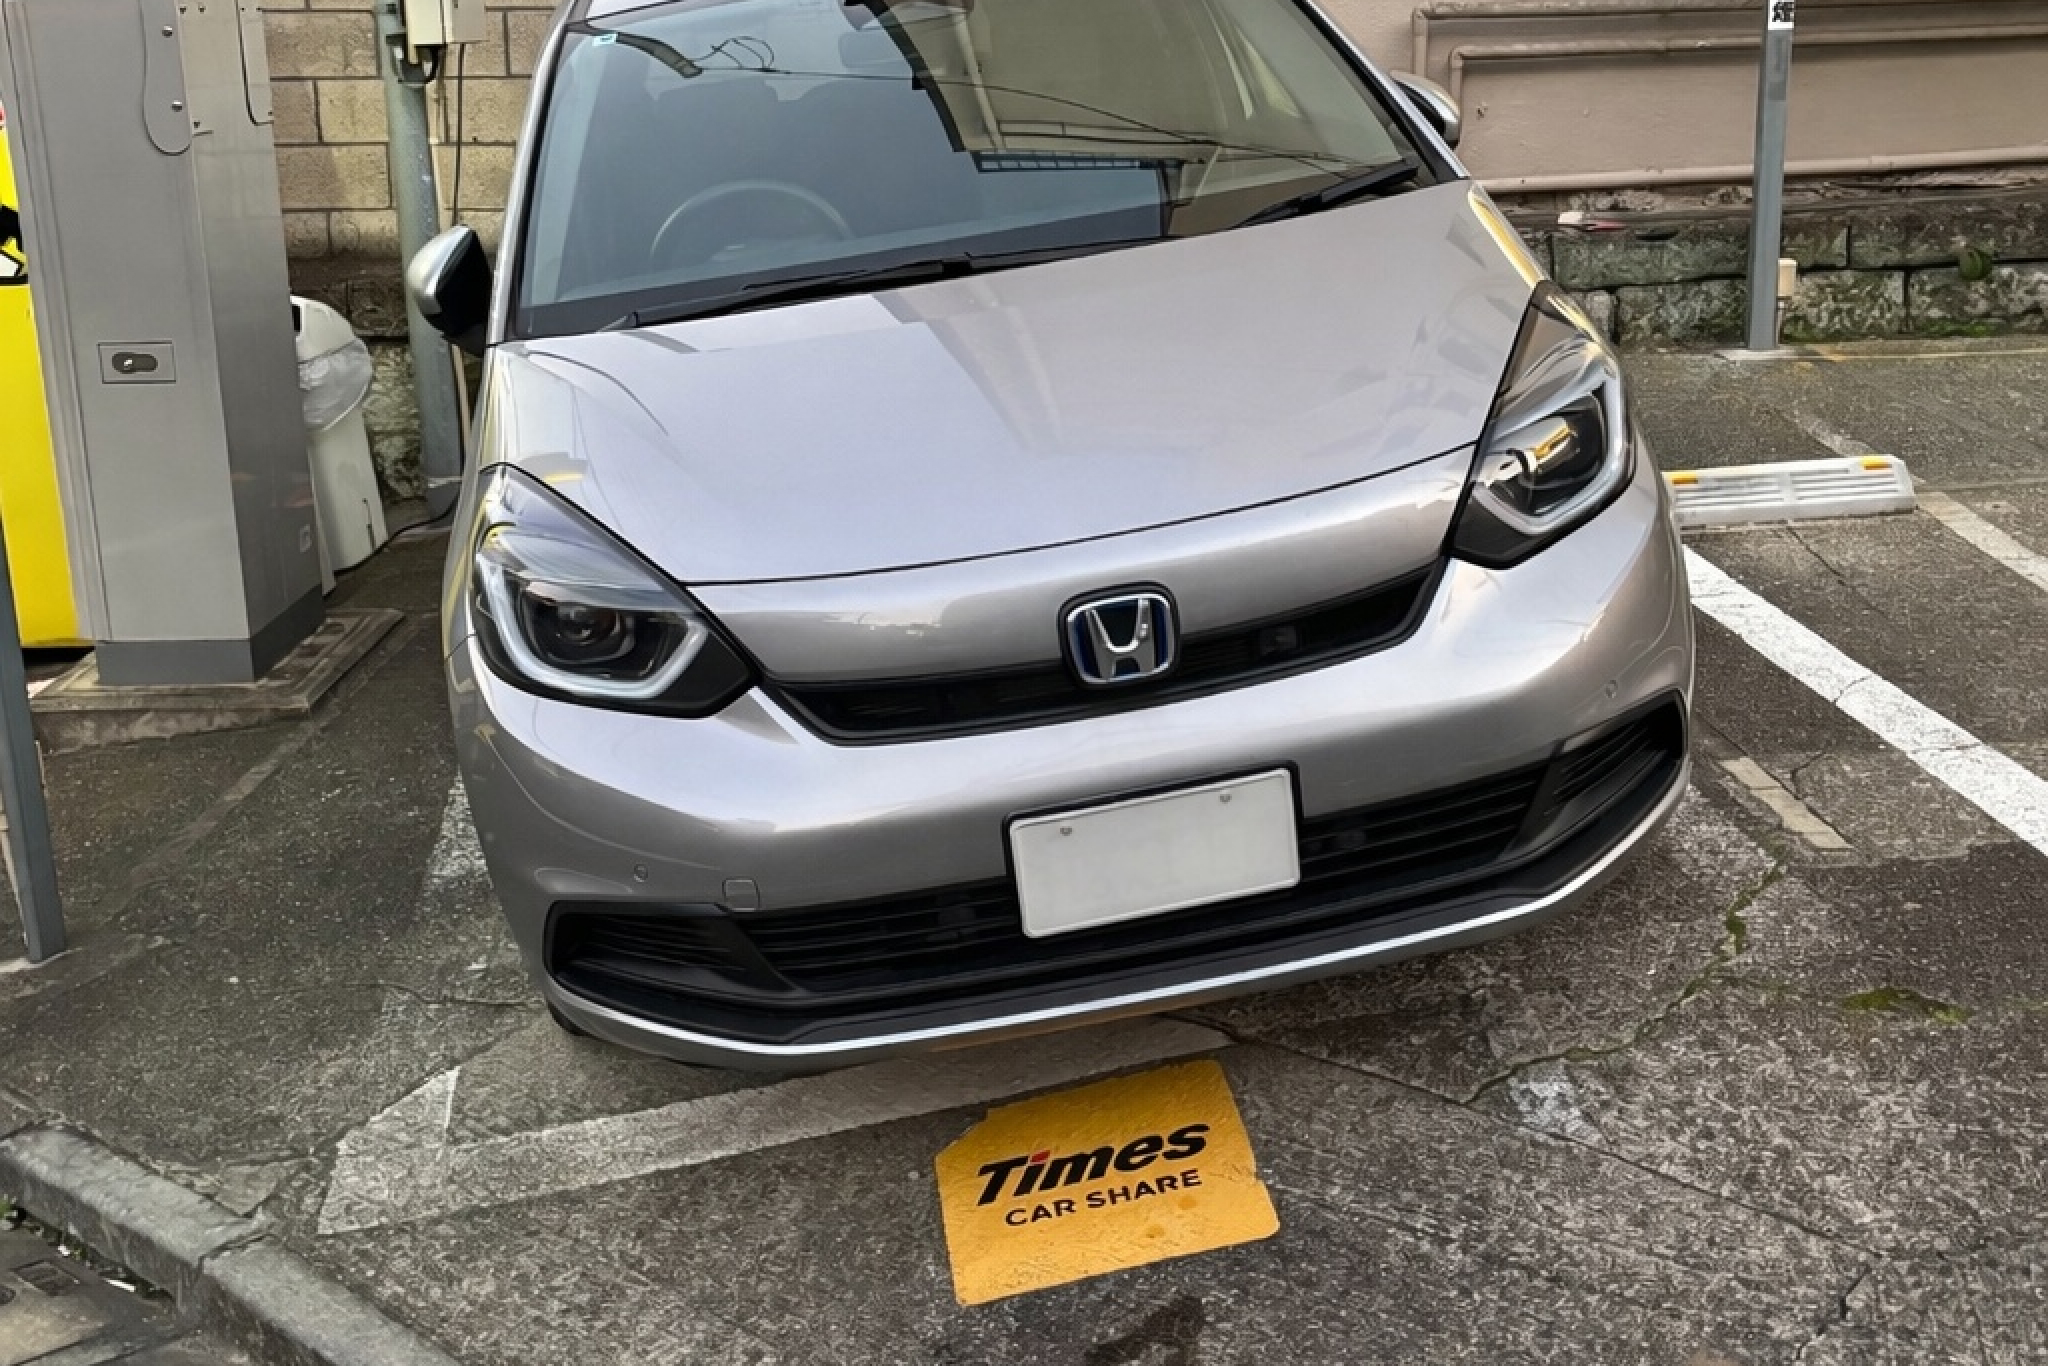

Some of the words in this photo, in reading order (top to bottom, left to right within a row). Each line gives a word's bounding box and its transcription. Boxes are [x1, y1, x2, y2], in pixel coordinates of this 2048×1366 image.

[976, 1123, 1210, 1206] Times
[1005, 1199, 1077, 1227] CAR
[1085, 1169, 1203, 1209] SHARE
